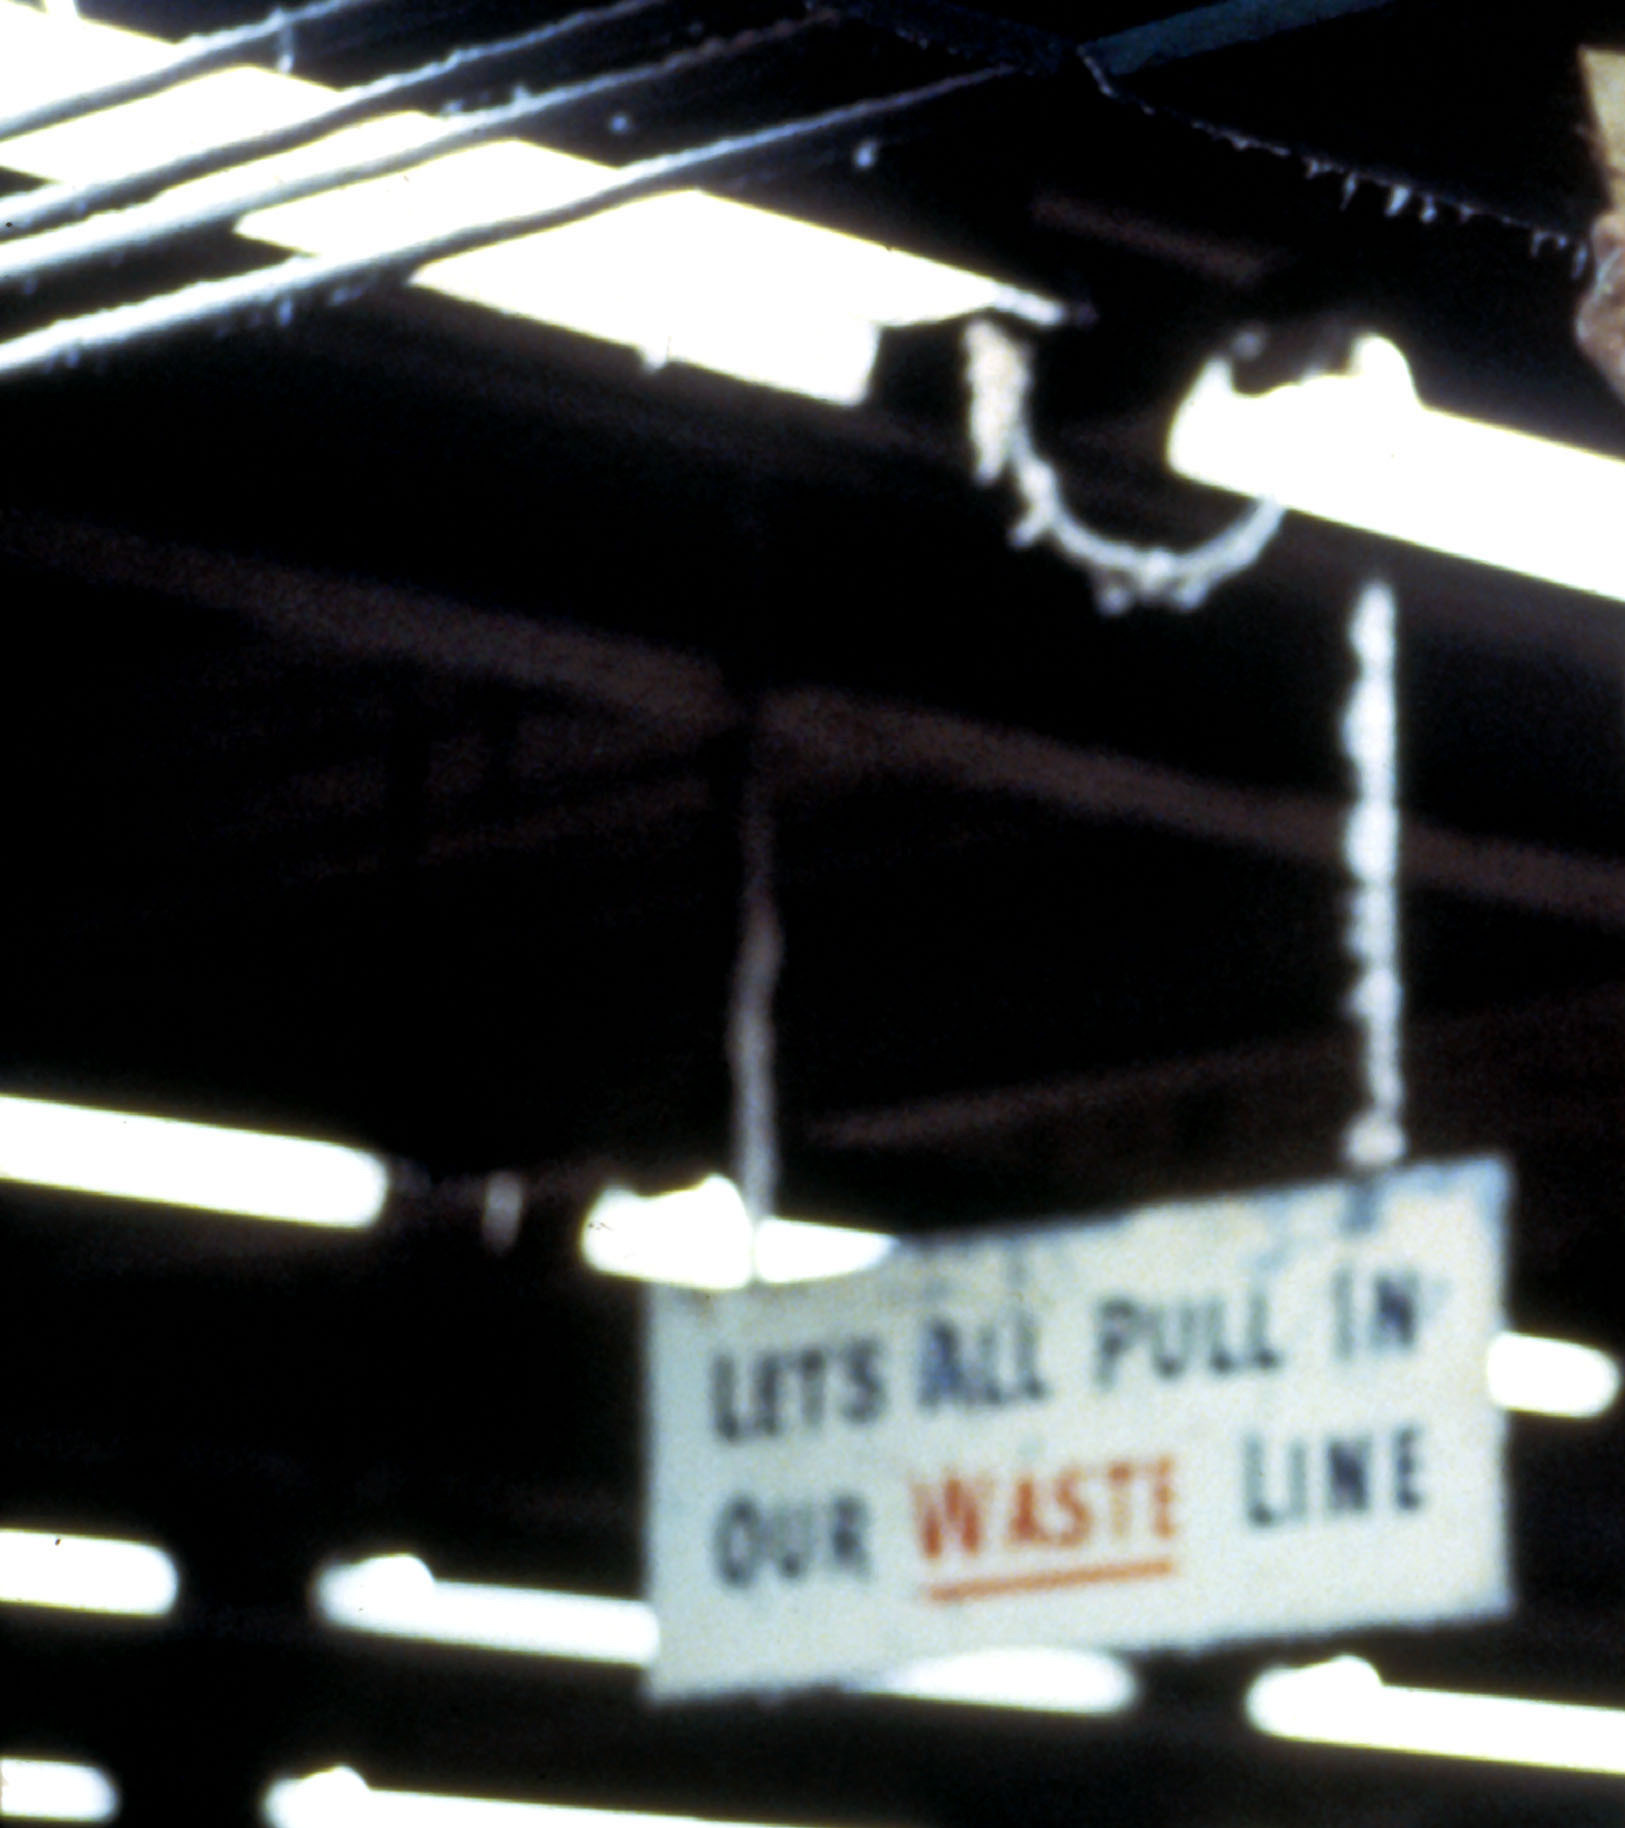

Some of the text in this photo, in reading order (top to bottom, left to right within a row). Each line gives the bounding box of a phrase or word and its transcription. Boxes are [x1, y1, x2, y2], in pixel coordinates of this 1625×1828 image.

[918, 1310, 1046, 1410] ALL
[1096, 1294, 1284, 1390] PULL
[1334, 1268, 1421, 1362] IN
[714, 1424, 1426, 1590] OUR WASTE LINE
